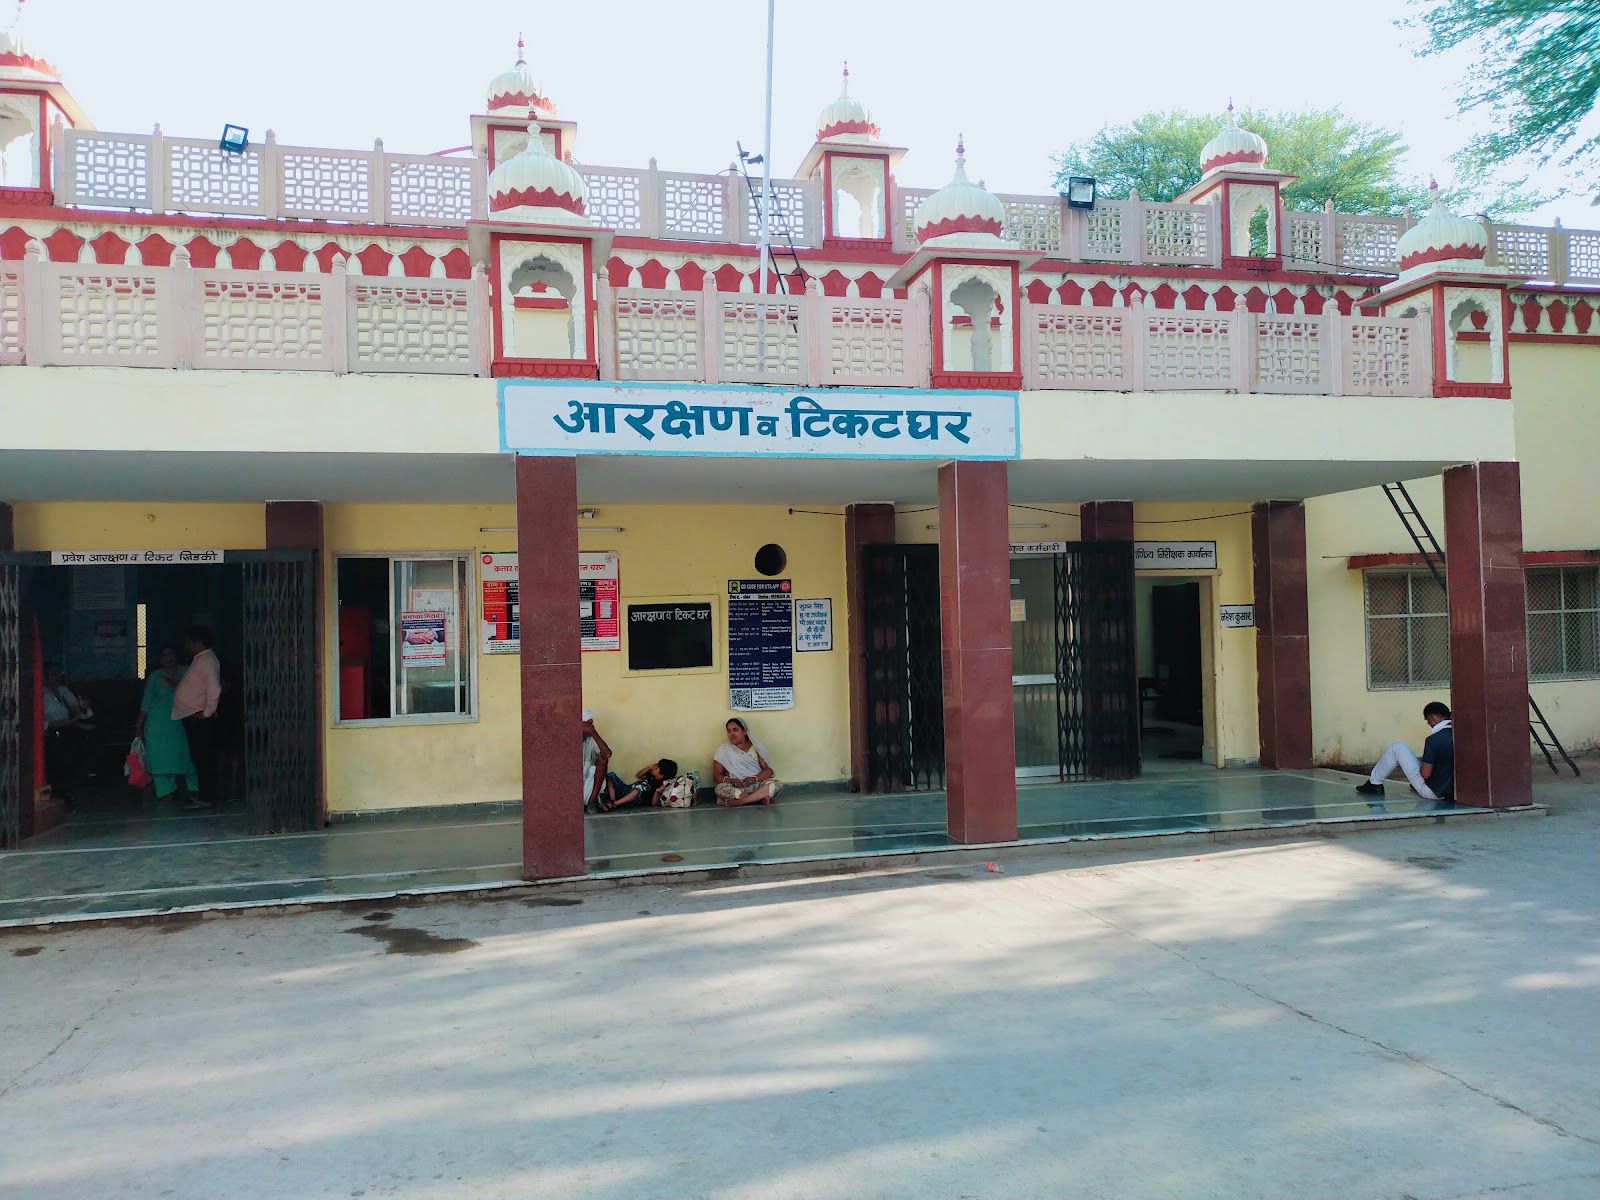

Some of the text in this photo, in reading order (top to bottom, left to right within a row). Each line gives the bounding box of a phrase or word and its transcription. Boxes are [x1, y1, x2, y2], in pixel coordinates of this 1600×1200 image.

[553, 400, 753, 441] आरक्षण
[757, 416, 779, 437] व
[61, 552, 85, 562] प्रवेश
[89, 553, 128, 562] आरक्षण
[131, 554, 139, 562] व
[144, 551, 174, 562] टिकट
[1135, 547, 1213, 559] ाणिज्य निरीक्षक कार्यालय
[631, 607, 711, 622] आरक्षण व टिकट घर
[1234, 611, 1252, 624] कुमार
